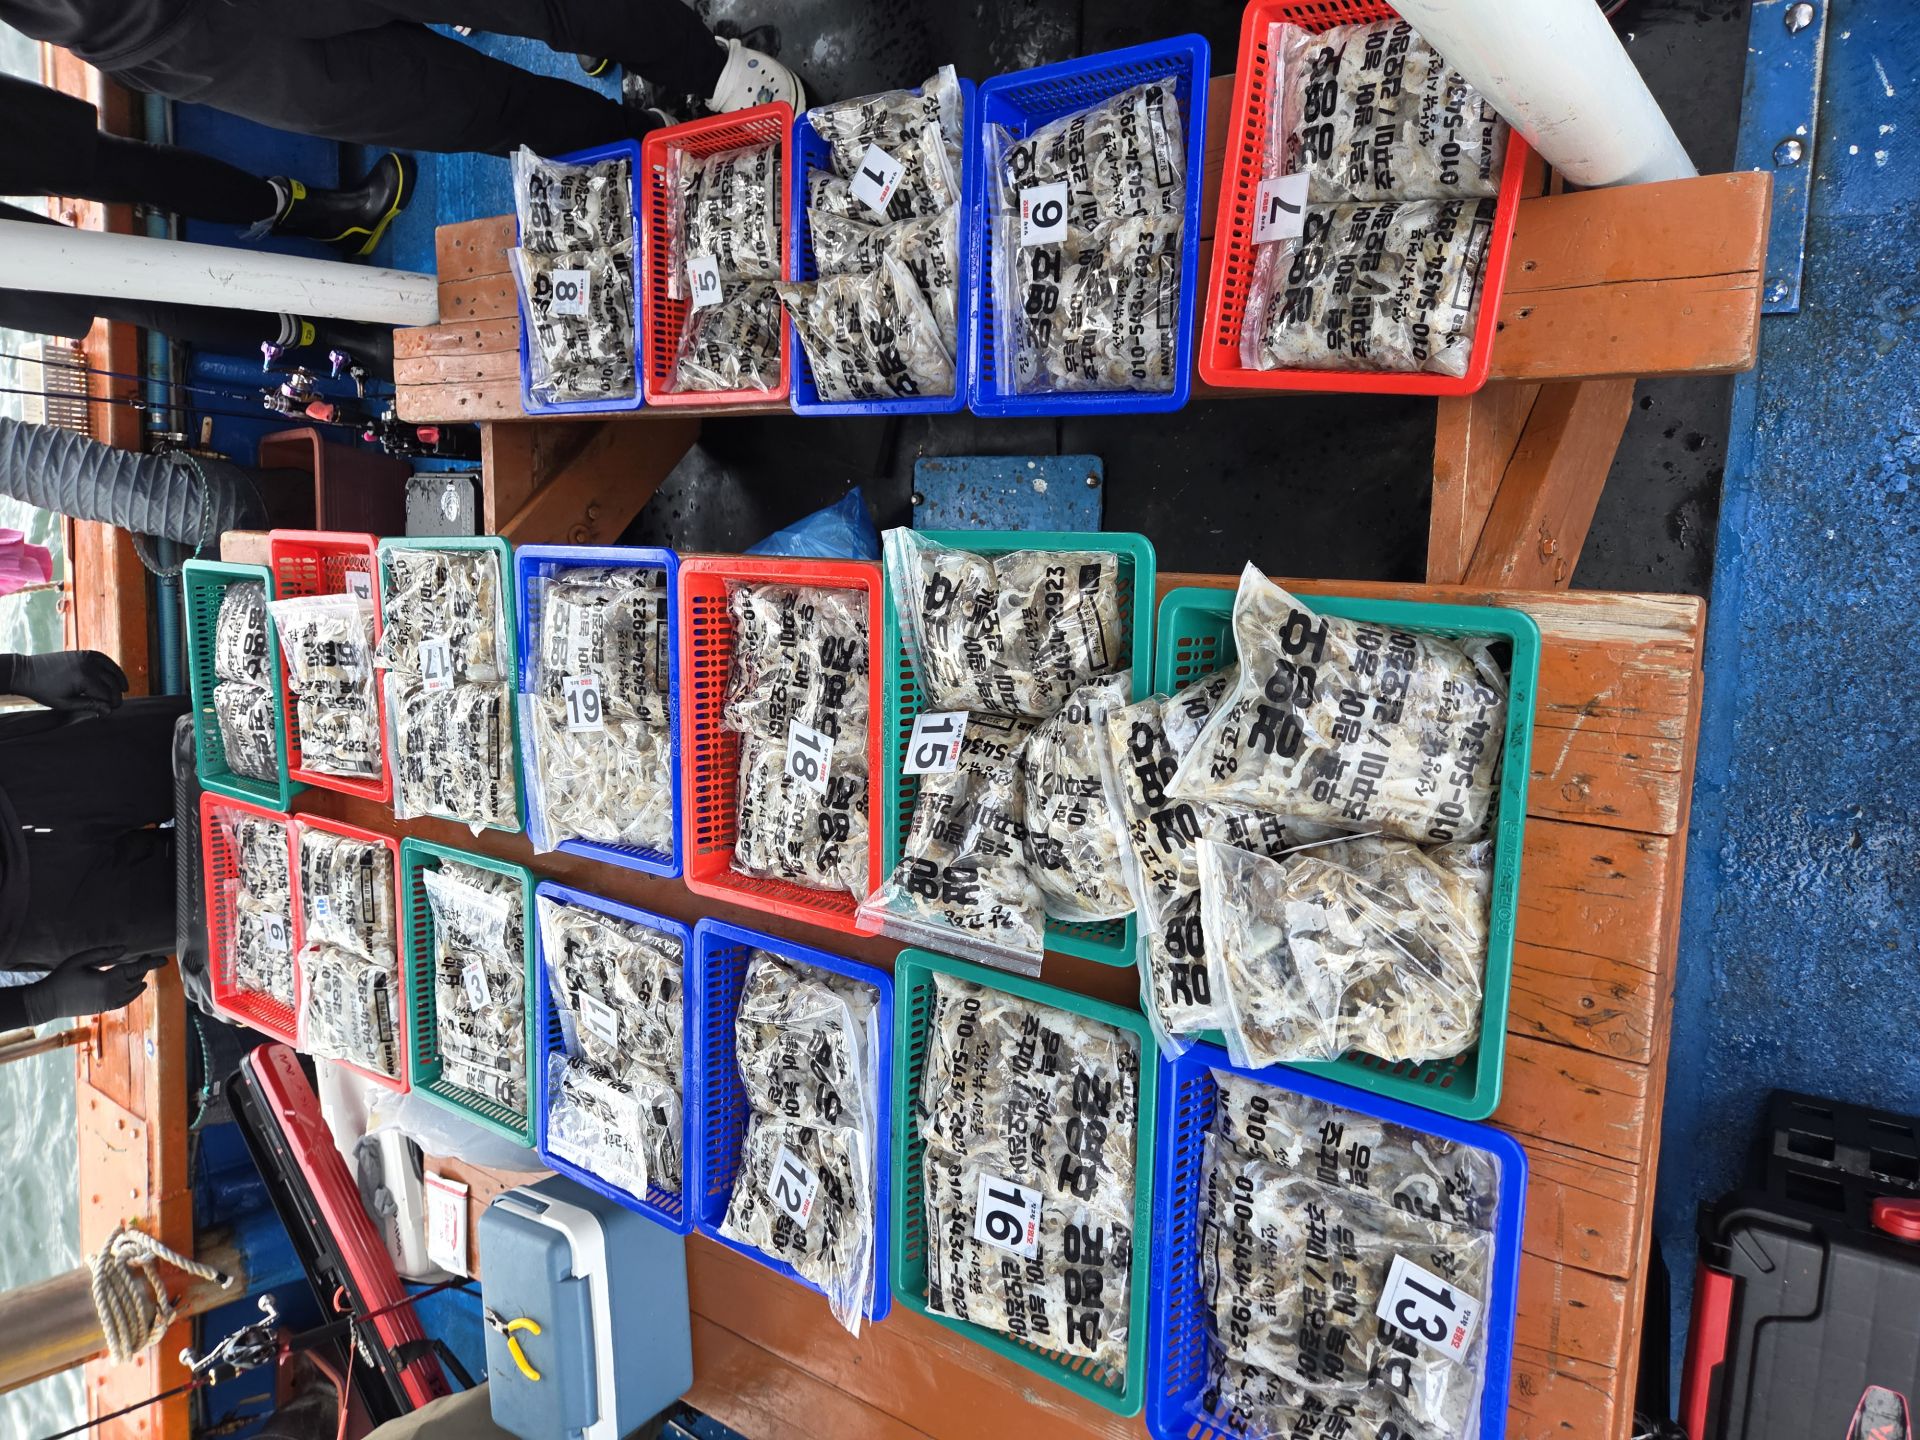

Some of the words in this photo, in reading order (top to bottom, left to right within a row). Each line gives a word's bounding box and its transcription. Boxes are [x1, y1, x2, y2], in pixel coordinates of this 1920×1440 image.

[1359, 30, 1387, 71] 농어
[1301, 41, 1347, 162] 경영호
[1355, 82, 1377, 128] 광어
[1067, 114, 1089, 183] 갑오징어
[1119, 95, 1148, 218] 0-5434-2923
[1285, 132, 1298, 174] 고항
[1374, 124, 1396, 190] 주꾸미
[1439, 73, 1469, 186] 010-5434
[1479, 126, 1494, 179] NAVER
[862, 166, 885, 187] 1
[1103, 131, 1125, 217] 선상낚시전문
[1349, 140, 1369, 185] 우럭
[609, 164, 623, 241] 5434-2923
[1031, 200, 1064, 229] 6
[1161, 190, 1172, 213] VER
[1269, 196, 1302, 225] 7
[1343, 207, 1375, 242] 농어
[924, 228, 952, 288] 장고항
[1359, 202, 1403, 272] 갑오징어
[555, 281, 578, 301] 8
[698, 270, 719, 291] 5
[1278, 210, 1337, 326] 경영호
[1331, 254, 1358, 295] 광어
[1391, 228, 1427, 323] 선상낚시전문
[1022, 247, 1061, 349] 경영호
[1111, 267, 1130, 350] 선상낚시전문
[1128, 232, 1155, 379] 010-5434-2923
[1014, 316, 1029, 374] 장고항
[1081, 329, 1099, 380] 주꾸미
[1160, 332, 1171, 376] NAVER
[1326, 309, 1347, 350] 우럭
[1350, 296, 1373, 358] 주꾸미
[353, 584, 369, 600] 4
[633, 597, 652, 722] 10-5434-2923
[963, 633, 987, 670] 광어
[1044, 565, 1077, 702] 0-5434-2923
[1349, 626, 1385, 677] 농어
[425, 647, 450, 679] 17
[1246, 608, 1330, 758] 경영호
[566, 688, 600, 723] 19
[1330, 687, 1370, 744] 광어
[1341, 751, 1389, 821] 주꾸미
[1372, 632, 1417, 724] 갑오징어
[791, 721, 821, 783] 18
[915, 717, 954, 769] 15
[1210, 698, 1252, 780] 장고항
[1427, 684, 1500, 842] 010-5434-2
[490, 783, 498, 817] NAVER
[956, 760, 1010, 786] 선상낚시
[1127, 720, 1202, 853] 경영호
[1312, 754, 1352, 804] 우럭
[928, 818, 966, 845] 광어
[1127, 818, 1178, 896] 장고항
[271, 923, 283, 941] 9
[944, 908, 1014, 930] 장고항
[472, 977, 484, 1004] 3
[588, 1001, 611, 1035] 11
[385, 1044, 396, 1075] NAVER
[1013, 1015, 1040, 1078] 주꾸미
[1036, 1031, 1060, 1078] 우럭
[969, 1040, 991, 1136] 선상낚시전문
[1057, 1070, 1113, 1201] 경영호
[1314, 1121, 1344, 1187] 주꾸미
[774, 1158, 808, 1213] 12
[1346, 1142, 1371, 1190] 우럭
[985, 1185, 1026, 1246] 16
[1443, 1169, 1476, 1221] 장고
[1110, 1223, 1133, 1270] 고항
[1302, 1203, 1329, 1260] 주꾸미
[1063, 1223, 1105, 1352] 경영호
[1230, 1175, 1255, 1352] 010-5434-2923
[1259, 1223, 1279, 1318] 선상낚시전문
[1001, 1260, 1028, 1336] 갑오징어
[1027, 1295, 1050, 1336] 농어
[1333, 1273, 1357, 1317] 광어
[1394, 1277, 1457, 1342] 13
[1296, 1289, 1327, 1383] 갑오징어
[1321, 1326, 1353, 1382] 농어
[1451, 1326, 1466, 1349] 경영호
